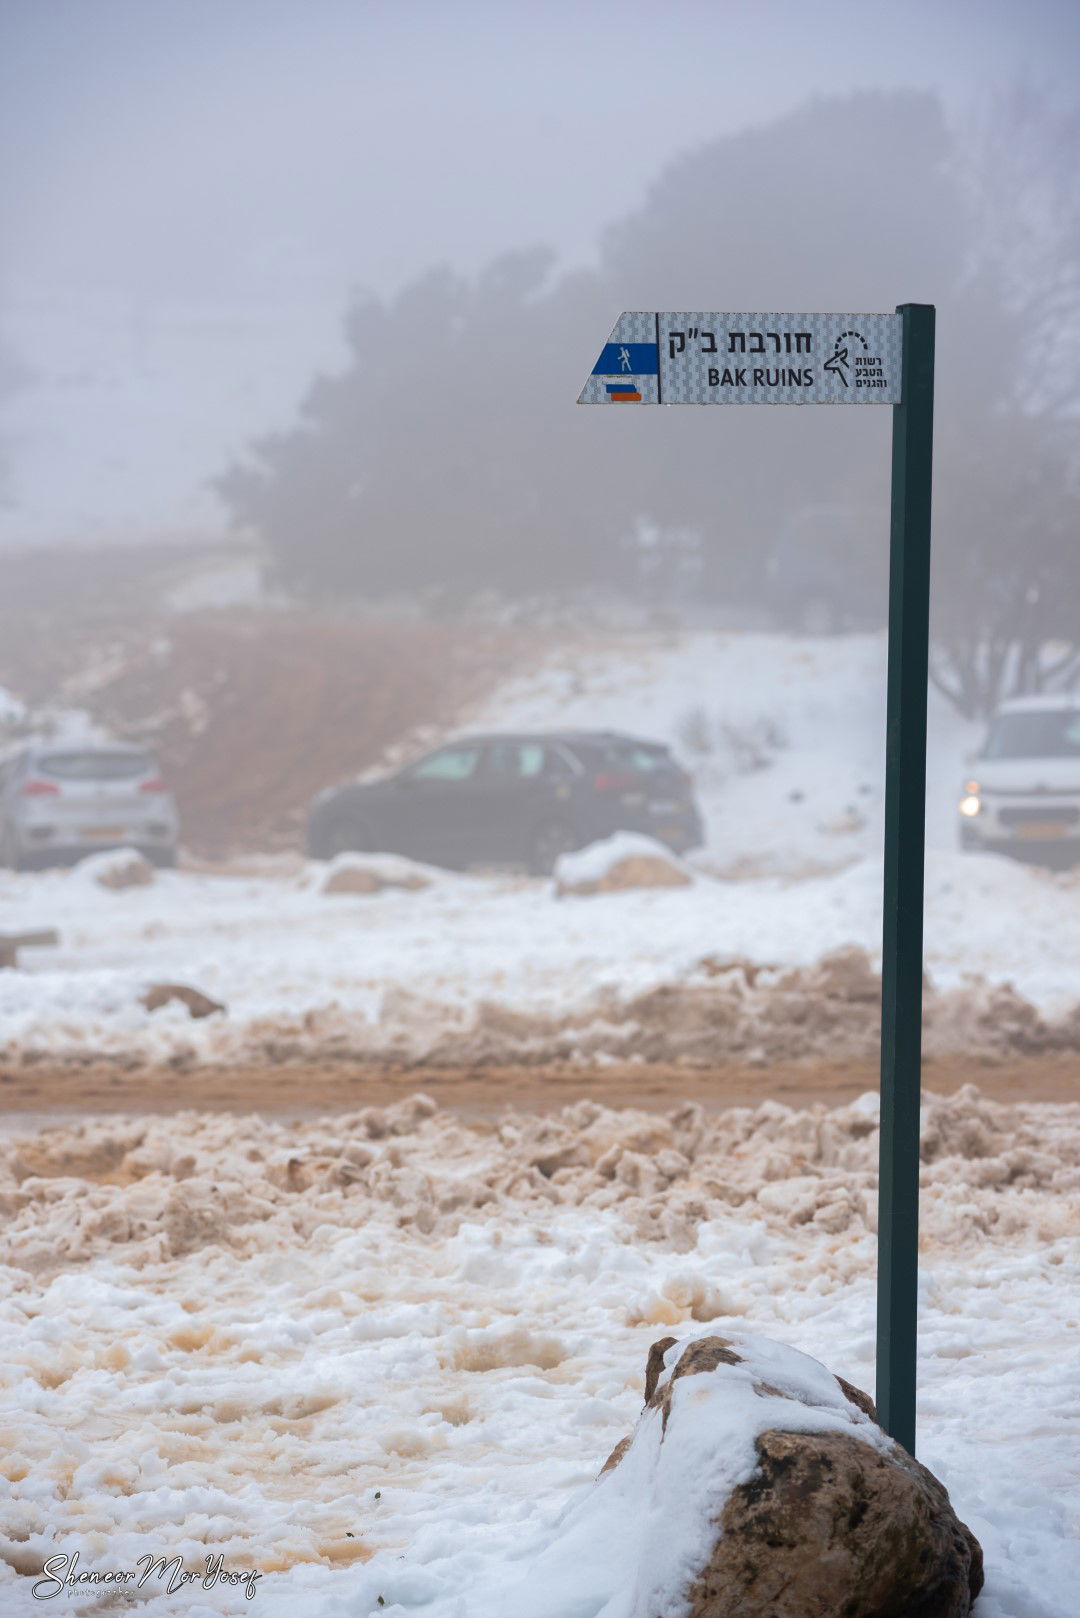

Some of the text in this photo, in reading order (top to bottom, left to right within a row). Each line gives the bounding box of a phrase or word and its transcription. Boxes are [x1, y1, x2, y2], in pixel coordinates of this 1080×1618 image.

[728, 332, 812, 353] חורבת
[855, 357, 882, 366] רשות
[855, 368, 883, 377] הטבע
[708, 368, 814, 387] BAK RUINS
[855, 379, 888, 387] והגנים
